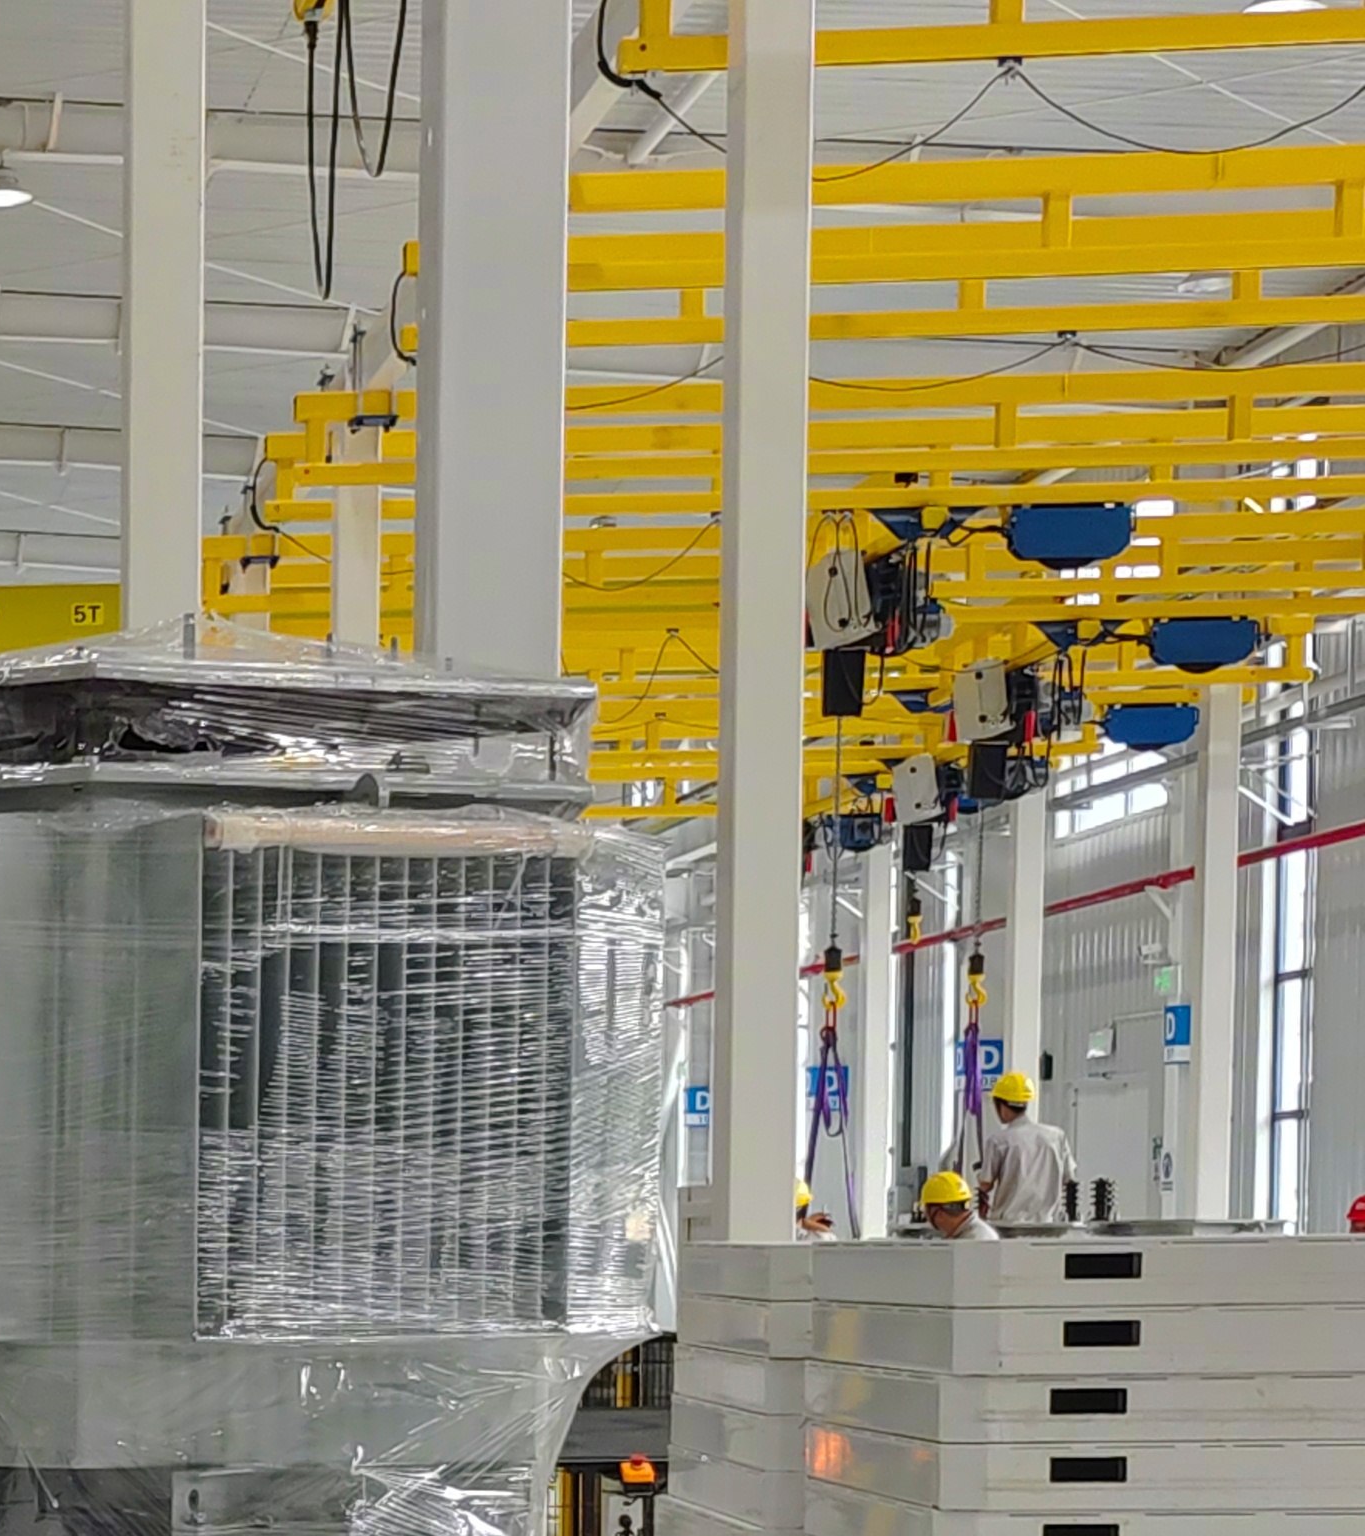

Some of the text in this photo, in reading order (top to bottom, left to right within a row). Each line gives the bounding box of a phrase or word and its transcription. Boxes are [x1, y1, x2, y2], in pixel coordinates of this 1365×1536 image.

[74, 605, 101, 624] 5T
[979, 1045, 1000, 1071] D
[695, 1091, 710, 1110] D
